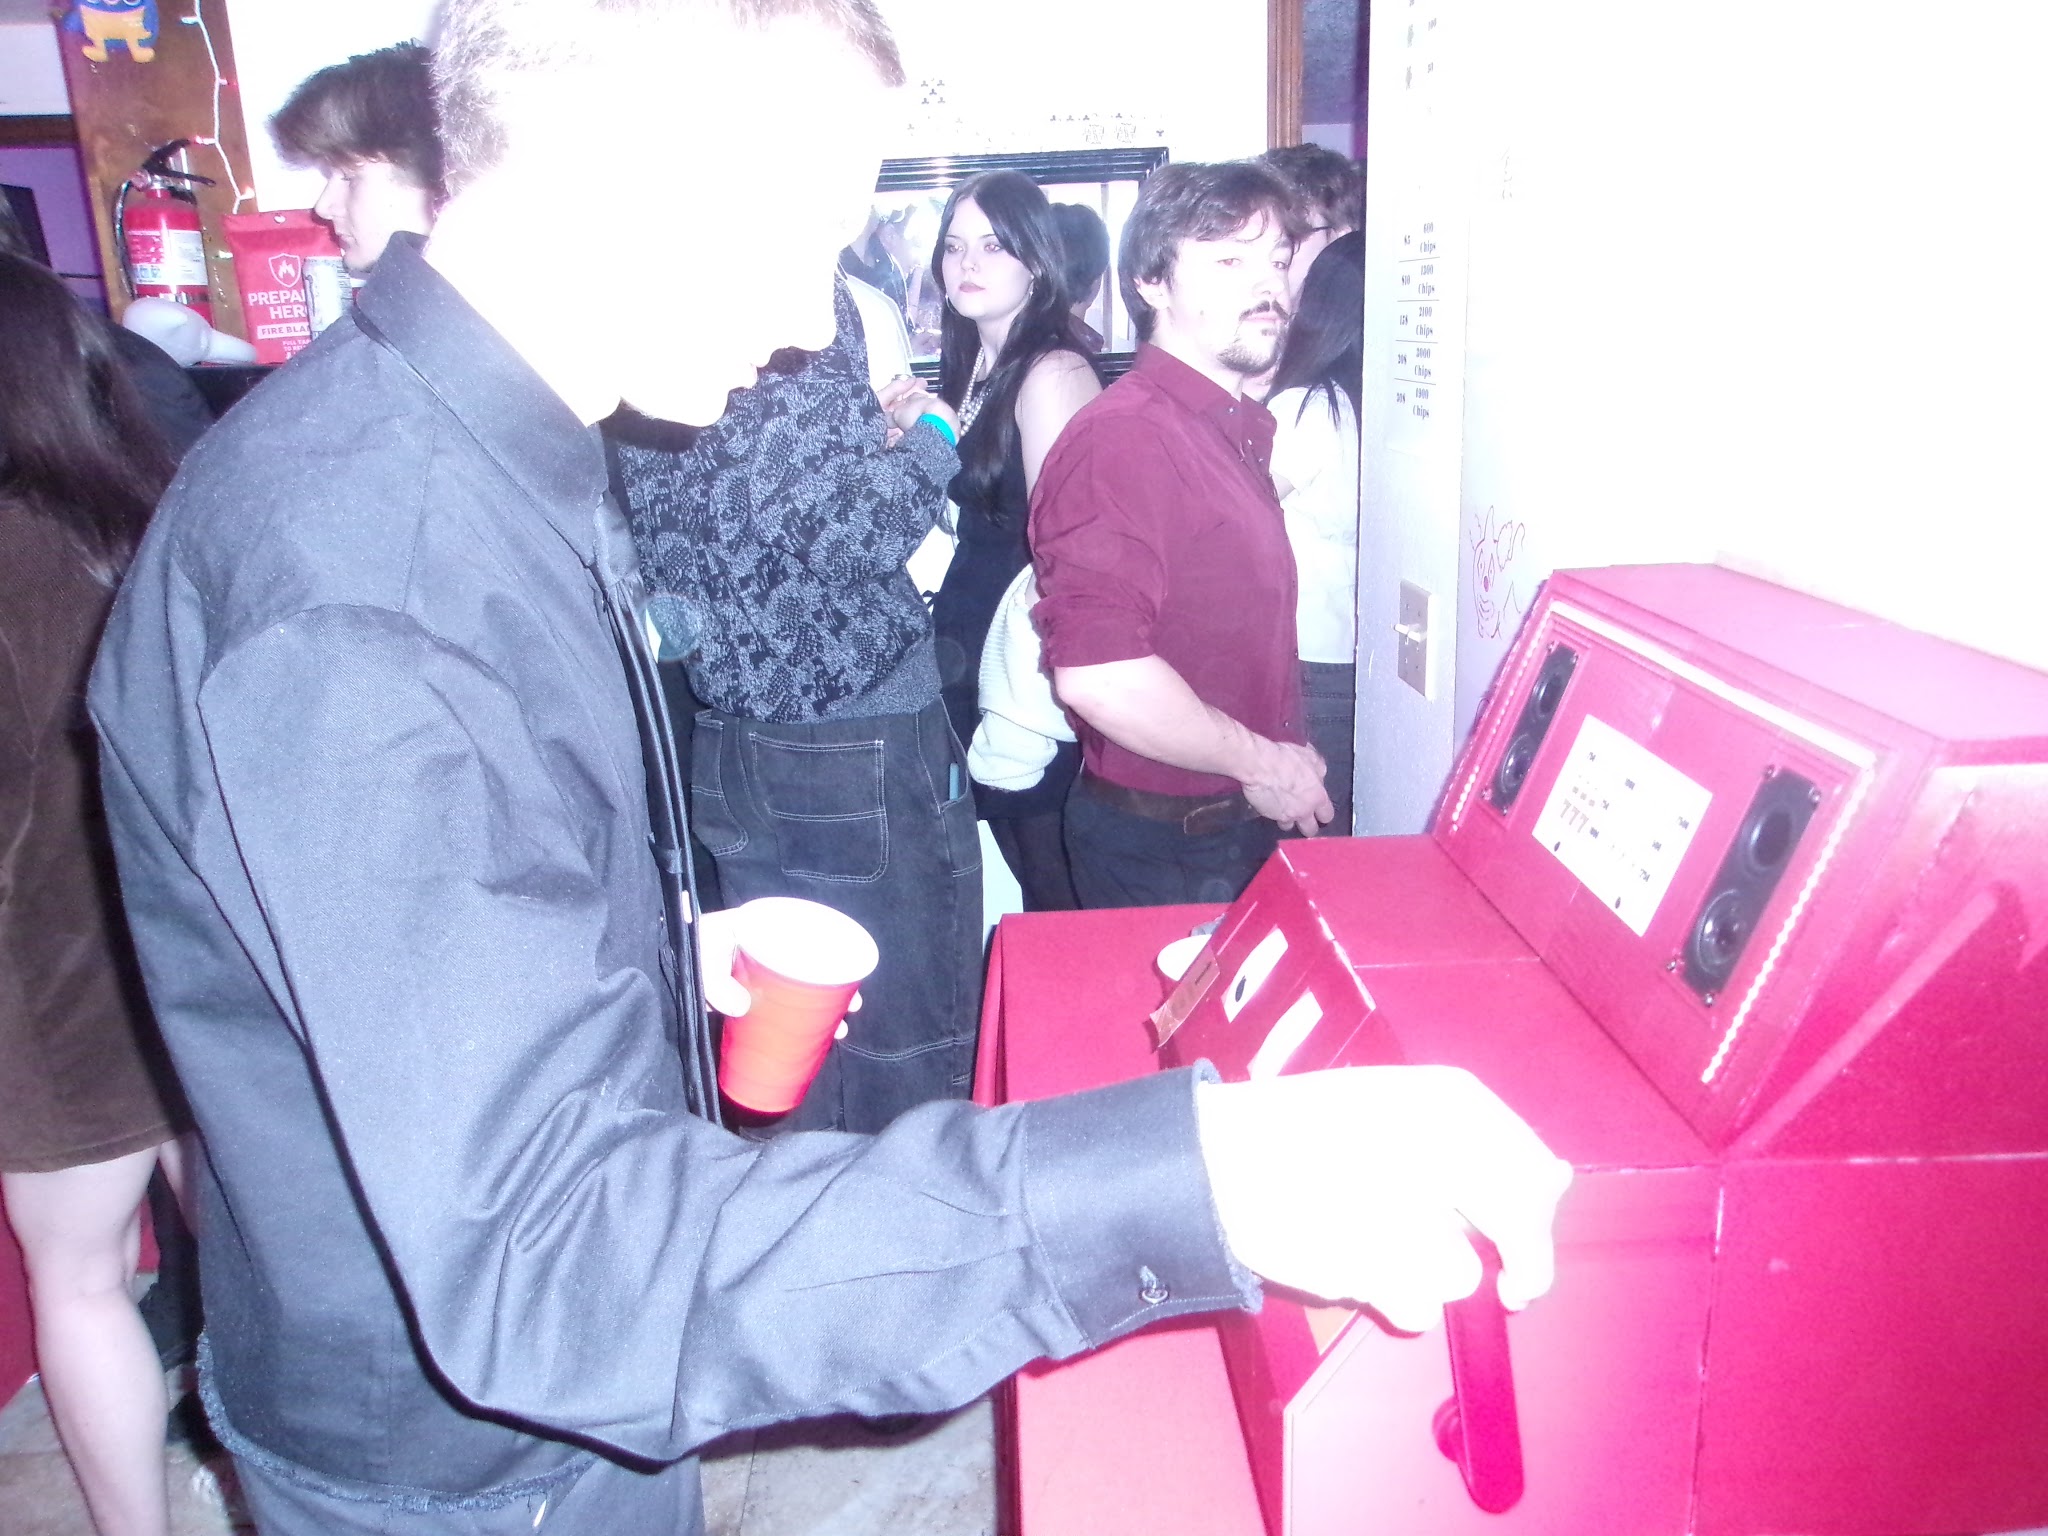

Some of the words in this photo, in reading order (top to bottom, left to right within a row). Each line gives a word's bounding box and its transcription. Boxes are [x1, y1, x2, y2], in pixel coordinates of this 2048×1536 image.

[1420, 240, 1436, 254] Chips
[1418, 282, 1435, 296] Chips
[1419, 306, 1432, 317] 2100
[262, 327, 284, 335] FIRE
[1416, 324, 1433, 338] Chips
[1415, 365, 1431, 379] Chips
[1413, 405, 1429, 419] Chips
